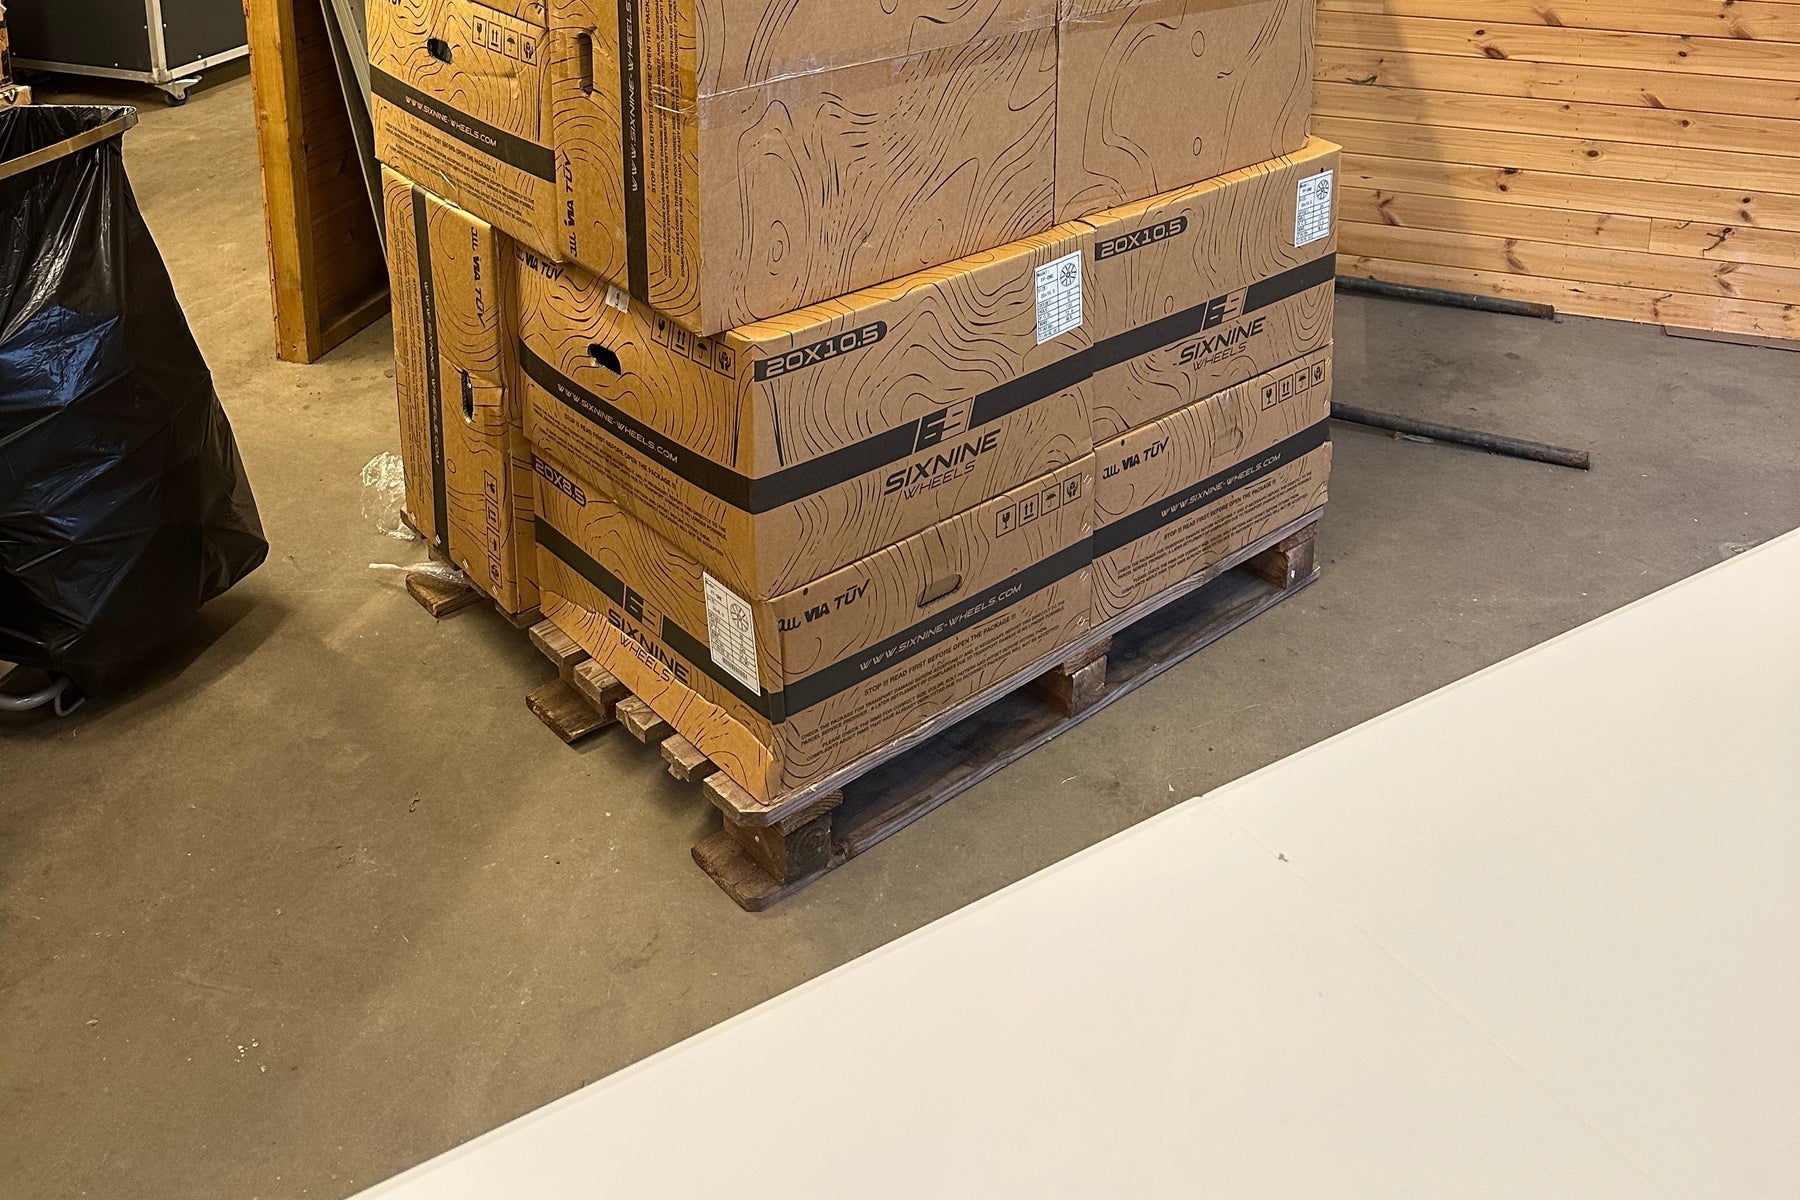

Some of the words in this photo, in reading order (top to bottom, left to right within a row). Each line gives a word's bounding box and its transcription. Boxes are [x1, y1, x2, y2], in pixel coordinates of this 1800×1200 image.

[1101, 218, 1181, 258] 20X10.5
[767, 322, 879, 377] 20X10.5
[1173, 316, 1266, 366] SIXNINE
[1193, 343, 1246, 371] WHEELS
[557, 383, 678, 464] WWW.SIXNINE-WHEELS.COM
[535, 458, 585, 505] 20X8.5
[884, 429, 999, 496] SIXNINE
[903, 461, 975, 499] WHEELS
[1121, 454, 1141, 471] VIA
[1160, 452, 1282, 517] WWW.SIXNINE-WHEELS.COM
[804, 603, 830, 623] VIA
[859, 582, 1023, 671] WWW.SIXNINE-WHEELS.COM
[608, 607, 690, 685] SIXNINE
[620, 634, 670, 683] WHEELS
[864, 681, 881, 696] STOP
[889, 668, 907, 683] READ
[908, 658, 926, 673] FIRST
[927, 646, 951, 663] BEFORE
[953, 636, 969, 651] OPEN
[971, 631, 980, 641] THE
[983, 616, 1010, 635] PACKAGE
